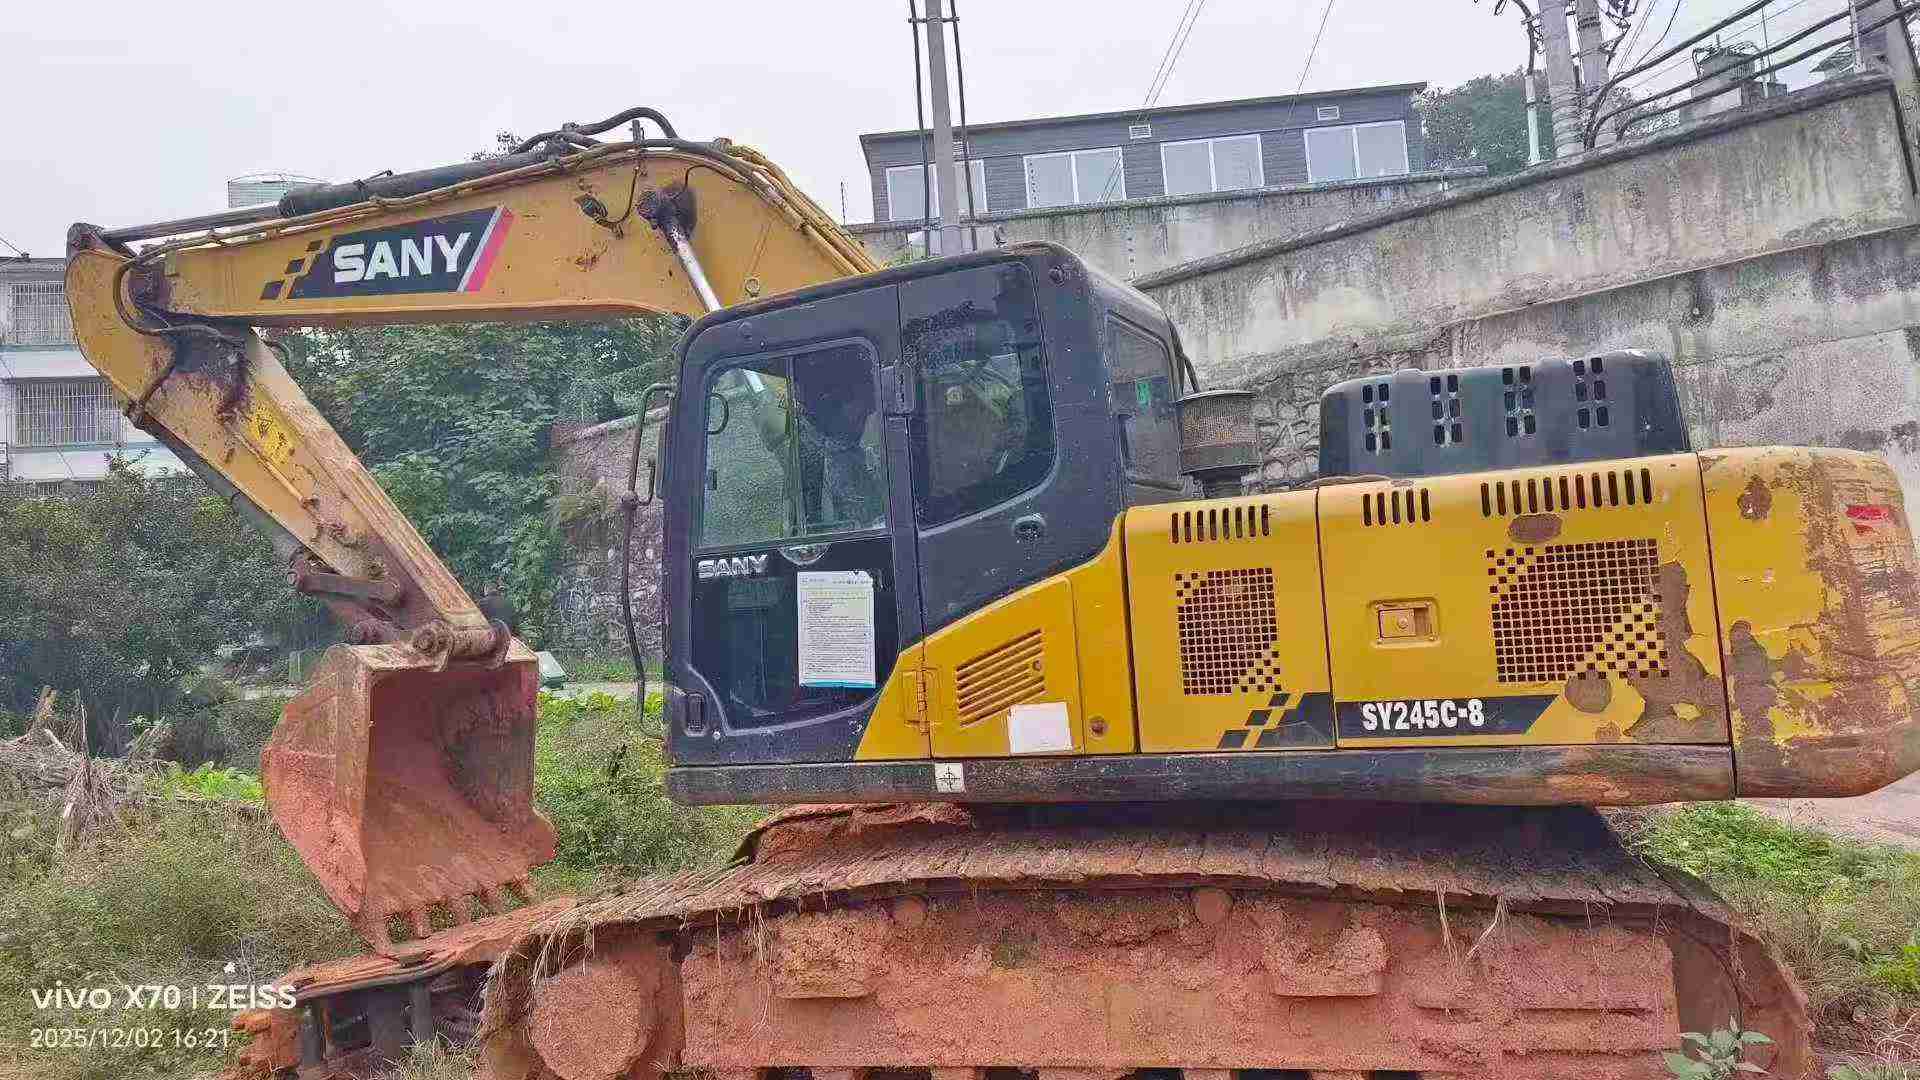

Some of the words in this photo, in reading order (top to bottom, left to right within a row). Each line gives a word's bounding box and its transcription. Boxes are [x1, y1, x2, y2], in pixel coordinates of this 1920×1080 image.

[334, 232, 472, 283] SANY
[697, 554, 768, 579] SANY
[1362, 698, 1485, 731] SY245C-8
